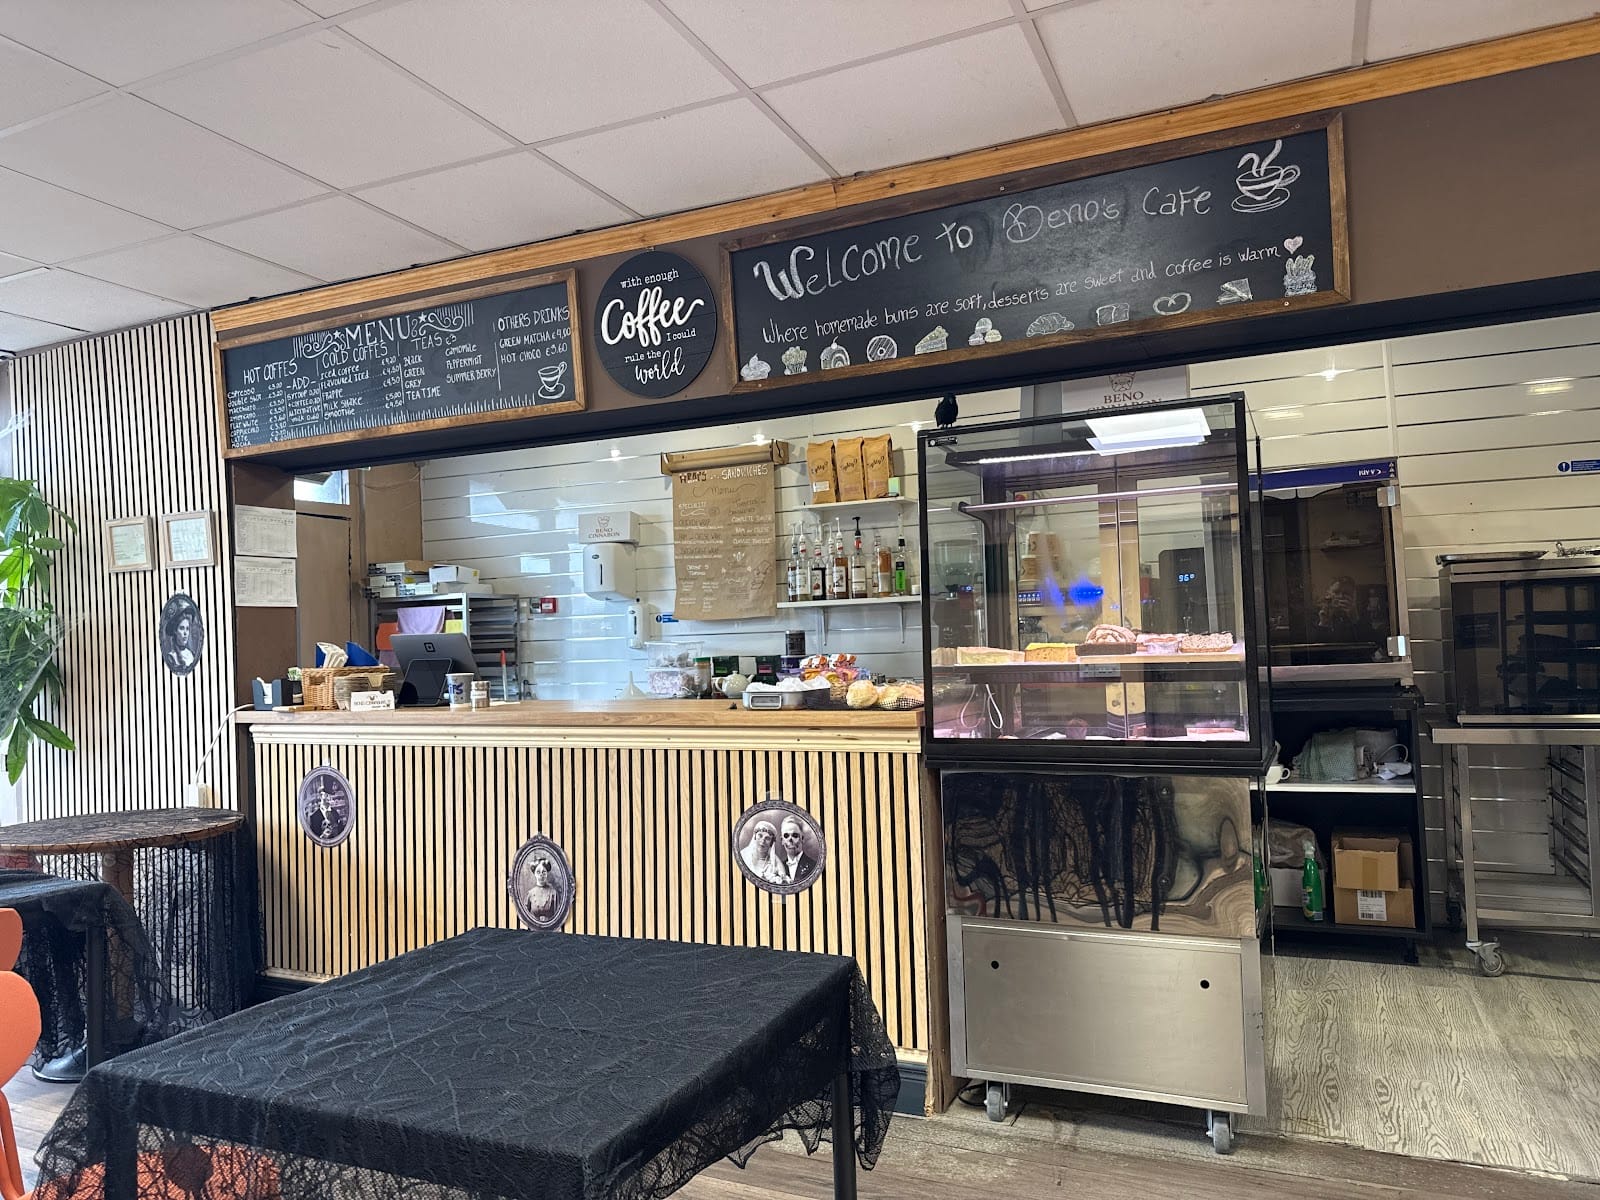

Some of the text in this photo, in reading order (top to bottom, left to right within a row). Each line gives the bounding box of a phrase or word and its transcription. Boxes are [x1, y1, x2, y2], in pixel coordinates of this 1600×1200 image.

[620, 268, 680, 289] with enough
[762, 318, 809, 344] Where
[815, 309, 878, 337] homemade
[884, 308, 919, 326] buns
[926, 300, 950, 317] are
[989, 281, 1049, 310] desserts
[1055, 280, 1077, 296] are
[1084, 271, 1123, 290] sweet
[1131, 261, 1158, 283] and
[1165, 258, 1212, 278] coffee
[1218, 252, 1232, 267] is
[498, 306, 570, 332] OTHERS DRINKS
[601, 286, 705, 347] Coffee
[345, 314, 412, 350] MENU
[411, 332, 443, 350] TEAS
[500, 336, 521, 349] GREEN
[523, 331, 551, 345] MATCHA
[666, 328, 697, 342] I could
[322, 342, 388, 369] COLD COFFES
[500, 353, 516, 364] HOT
[519, 348, 542, 362] CHOCO
[624, 350, 661, 363] rule the
[634, 346, 686, 384] world
[243, 360, 298, 385] HOT COFFES
[1103, 391, 1144, 404] BENO
